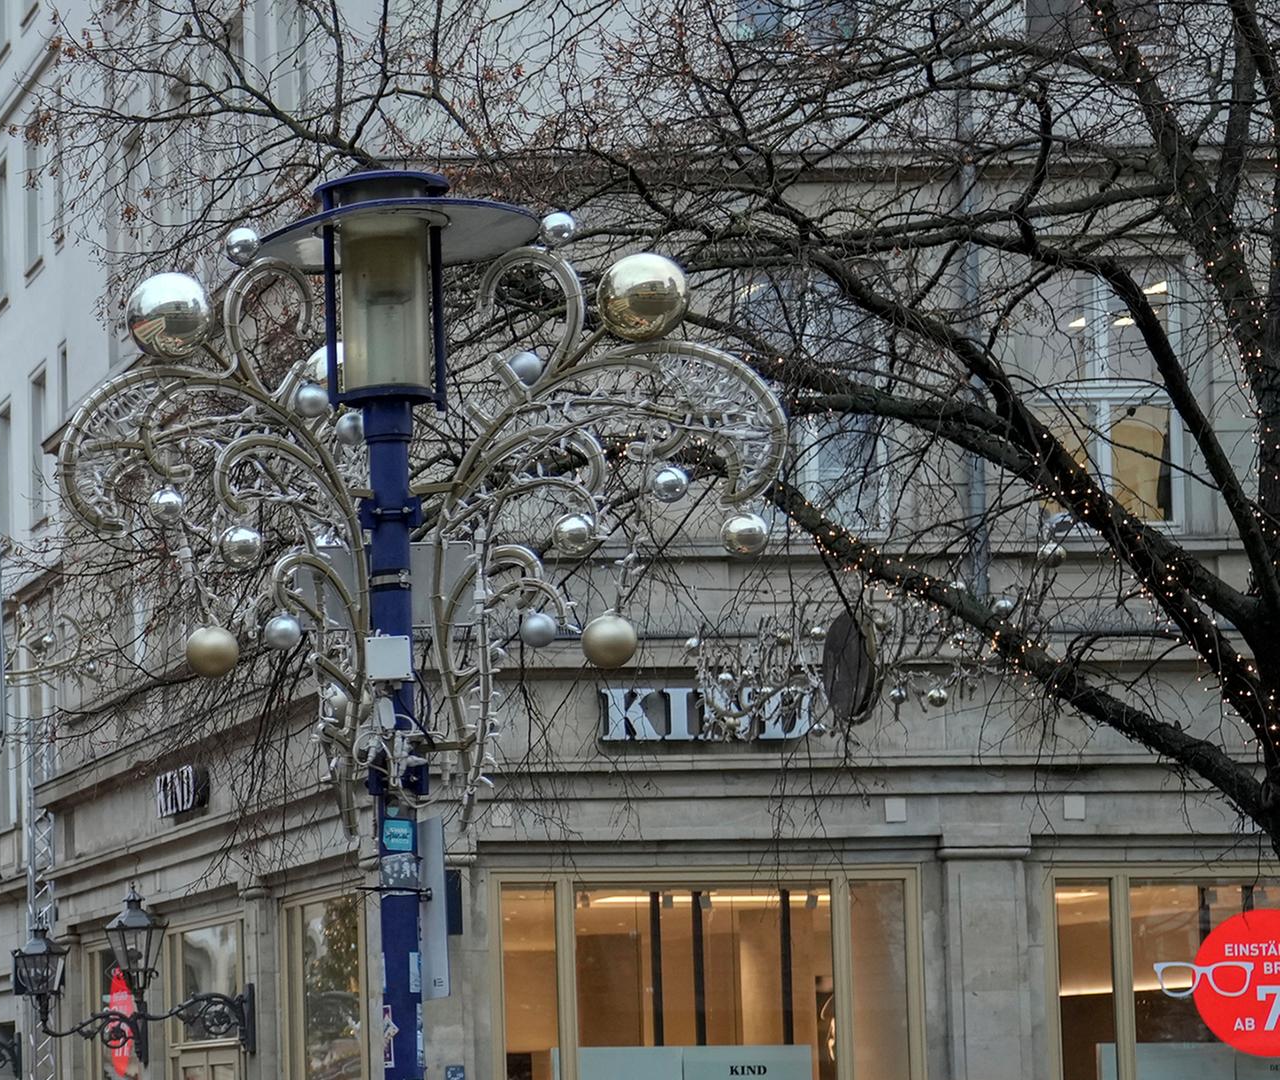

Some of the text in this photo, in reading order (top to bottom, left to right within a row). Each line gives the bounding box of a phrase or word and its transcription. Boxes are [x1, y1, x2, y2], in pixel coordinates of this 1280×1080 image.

[156, 764, 194, 818] KIND
[1224, 941, 1280, 957] EINSTÄ
[1234, 1018, 1255, 1031] AB
[729, 1064, 768, 1077] KIND
